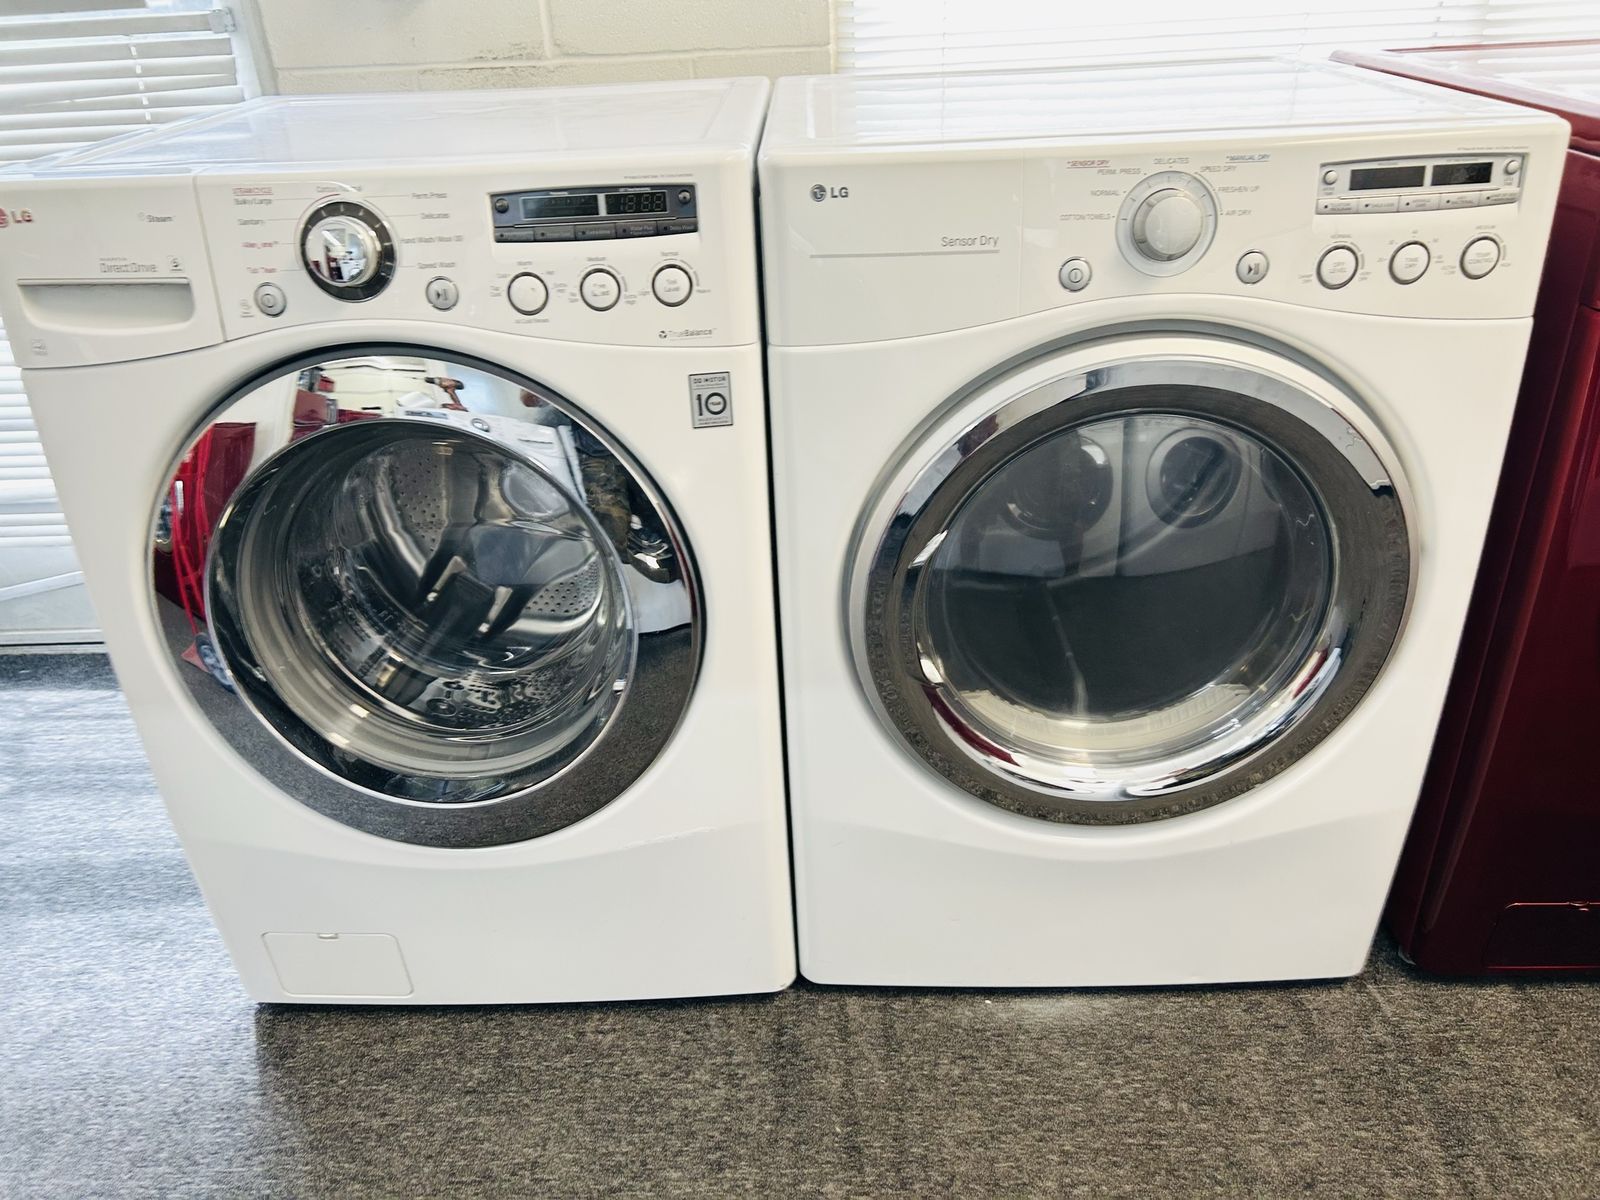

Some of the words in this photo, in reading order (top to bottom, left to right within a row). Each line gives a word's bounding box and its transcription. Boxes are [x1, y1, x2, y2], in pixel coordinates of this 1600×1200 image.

[830, 187, 849, 199] LG
[11, 210, 34, 224] LG
[940, 236, 978, 247] Sensor
[979, 234, 1000, 248] Dry
[696, 391, 727, 416] 10
